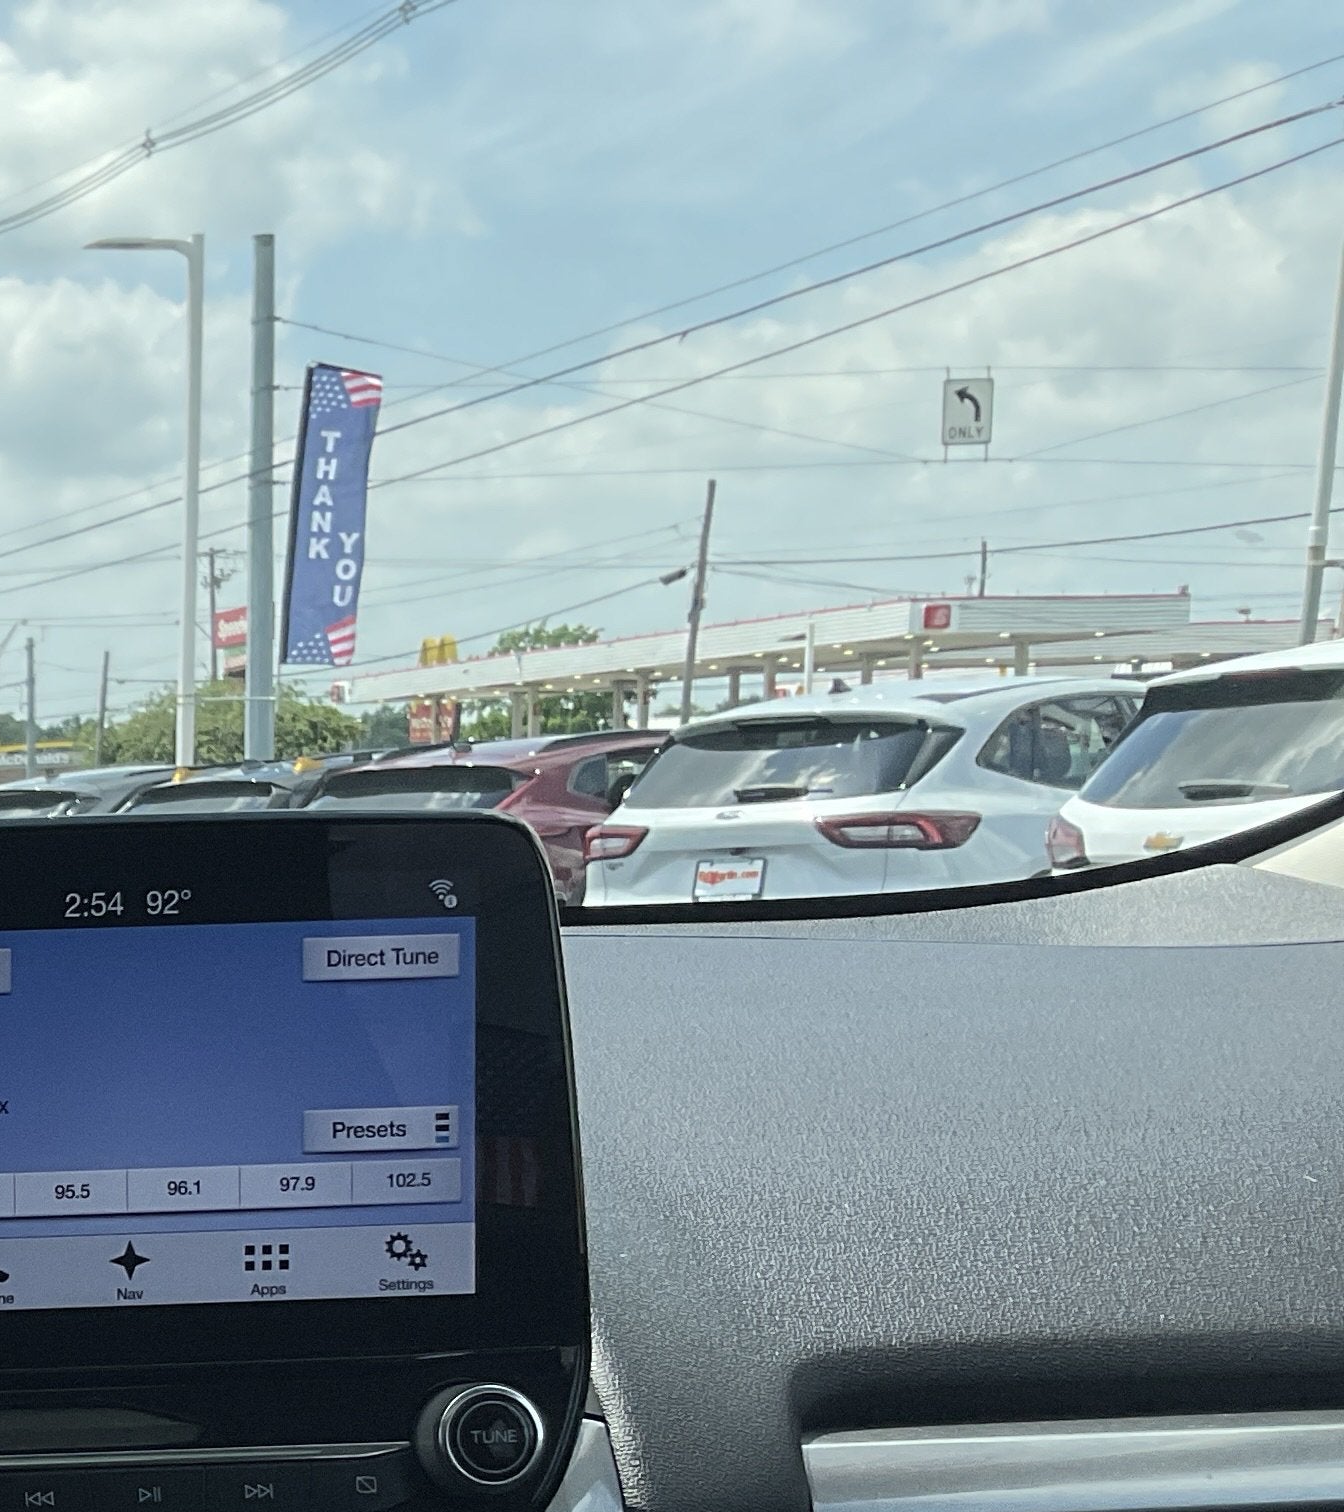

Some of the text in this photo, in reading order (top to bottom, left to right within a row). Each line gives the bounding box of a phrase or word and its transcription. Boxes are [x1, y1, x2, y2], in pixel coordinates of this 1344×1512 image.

[947, 426, 984, 439] ONLY
[308, 431, 342, 560] THANK
[332, 532, 360, 607] YOU
[64, 891, 124, 917] 2:54
[146, 889, 192, 915] 92°
[326, 948, 439, 968] Direct Tune
[332, 1121, 407, 1138] Presets
[167, 1180, 201, 1196] 96.1
[280, 1176, 316, 1192] 97.9
[386, 1172, 431, 1188] 102.5
[54, 1184, 90, 1200] 95.5
[250, 1283, 286, 1297] Apps
[378, 1278, 434, 1292] Settings
[116, 1288, 144, 1300] Nav
[469, 1428, 518, 1445] TUNE
